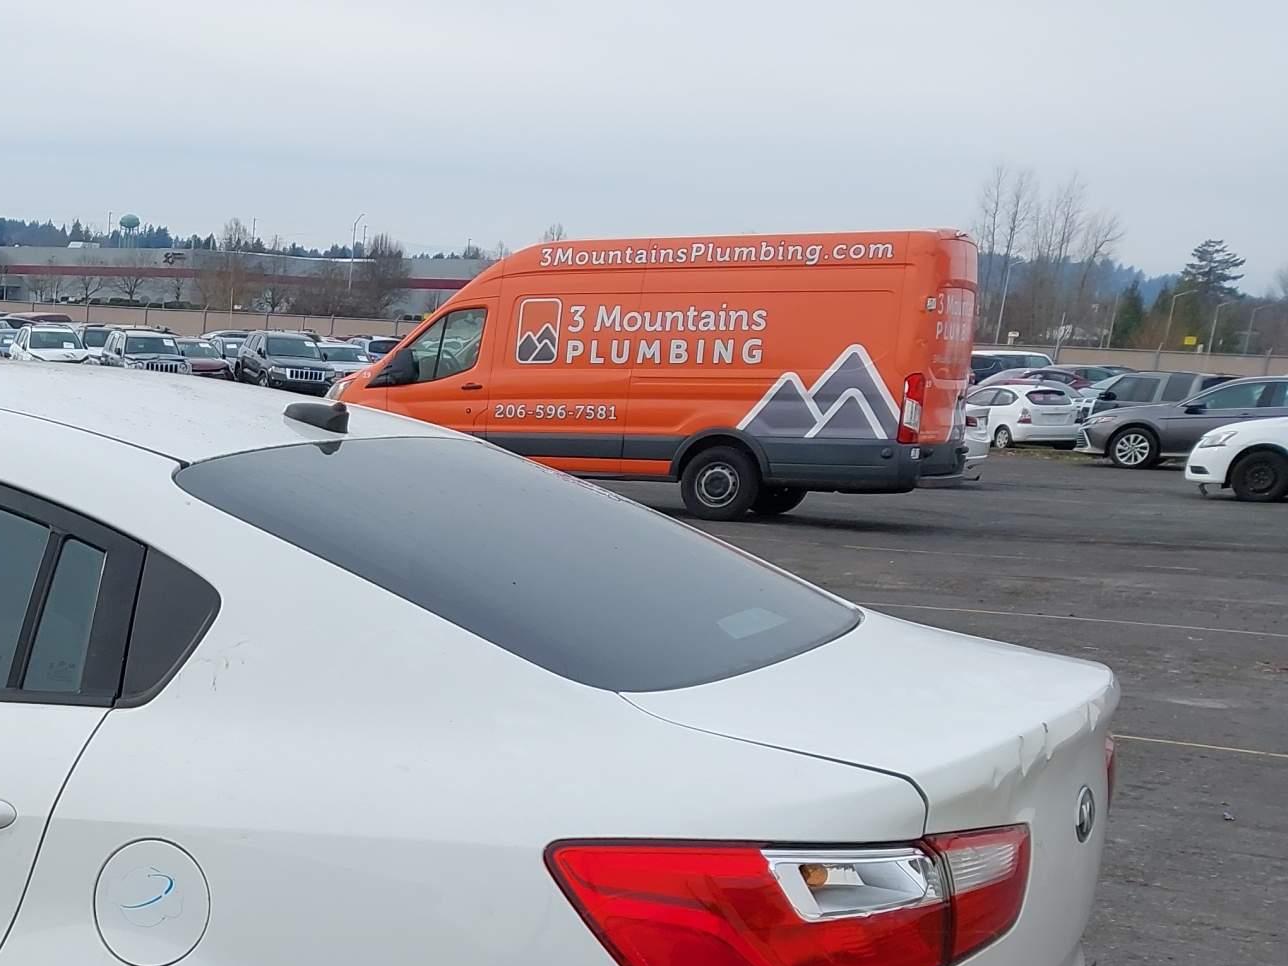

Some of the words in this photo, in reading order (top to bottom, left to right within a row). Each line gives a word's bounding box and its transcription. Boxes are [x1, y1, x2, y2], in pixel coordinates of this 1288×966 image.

[539, 240, 894, 267] 3MountainsPlumbing.com
[567, 304, 586, 333] 3
[593, 303, 768, 332] Mountains
[566, 338, 763, 364] PLUMBING
[494, 403, 617, 420] 206-596-7581
